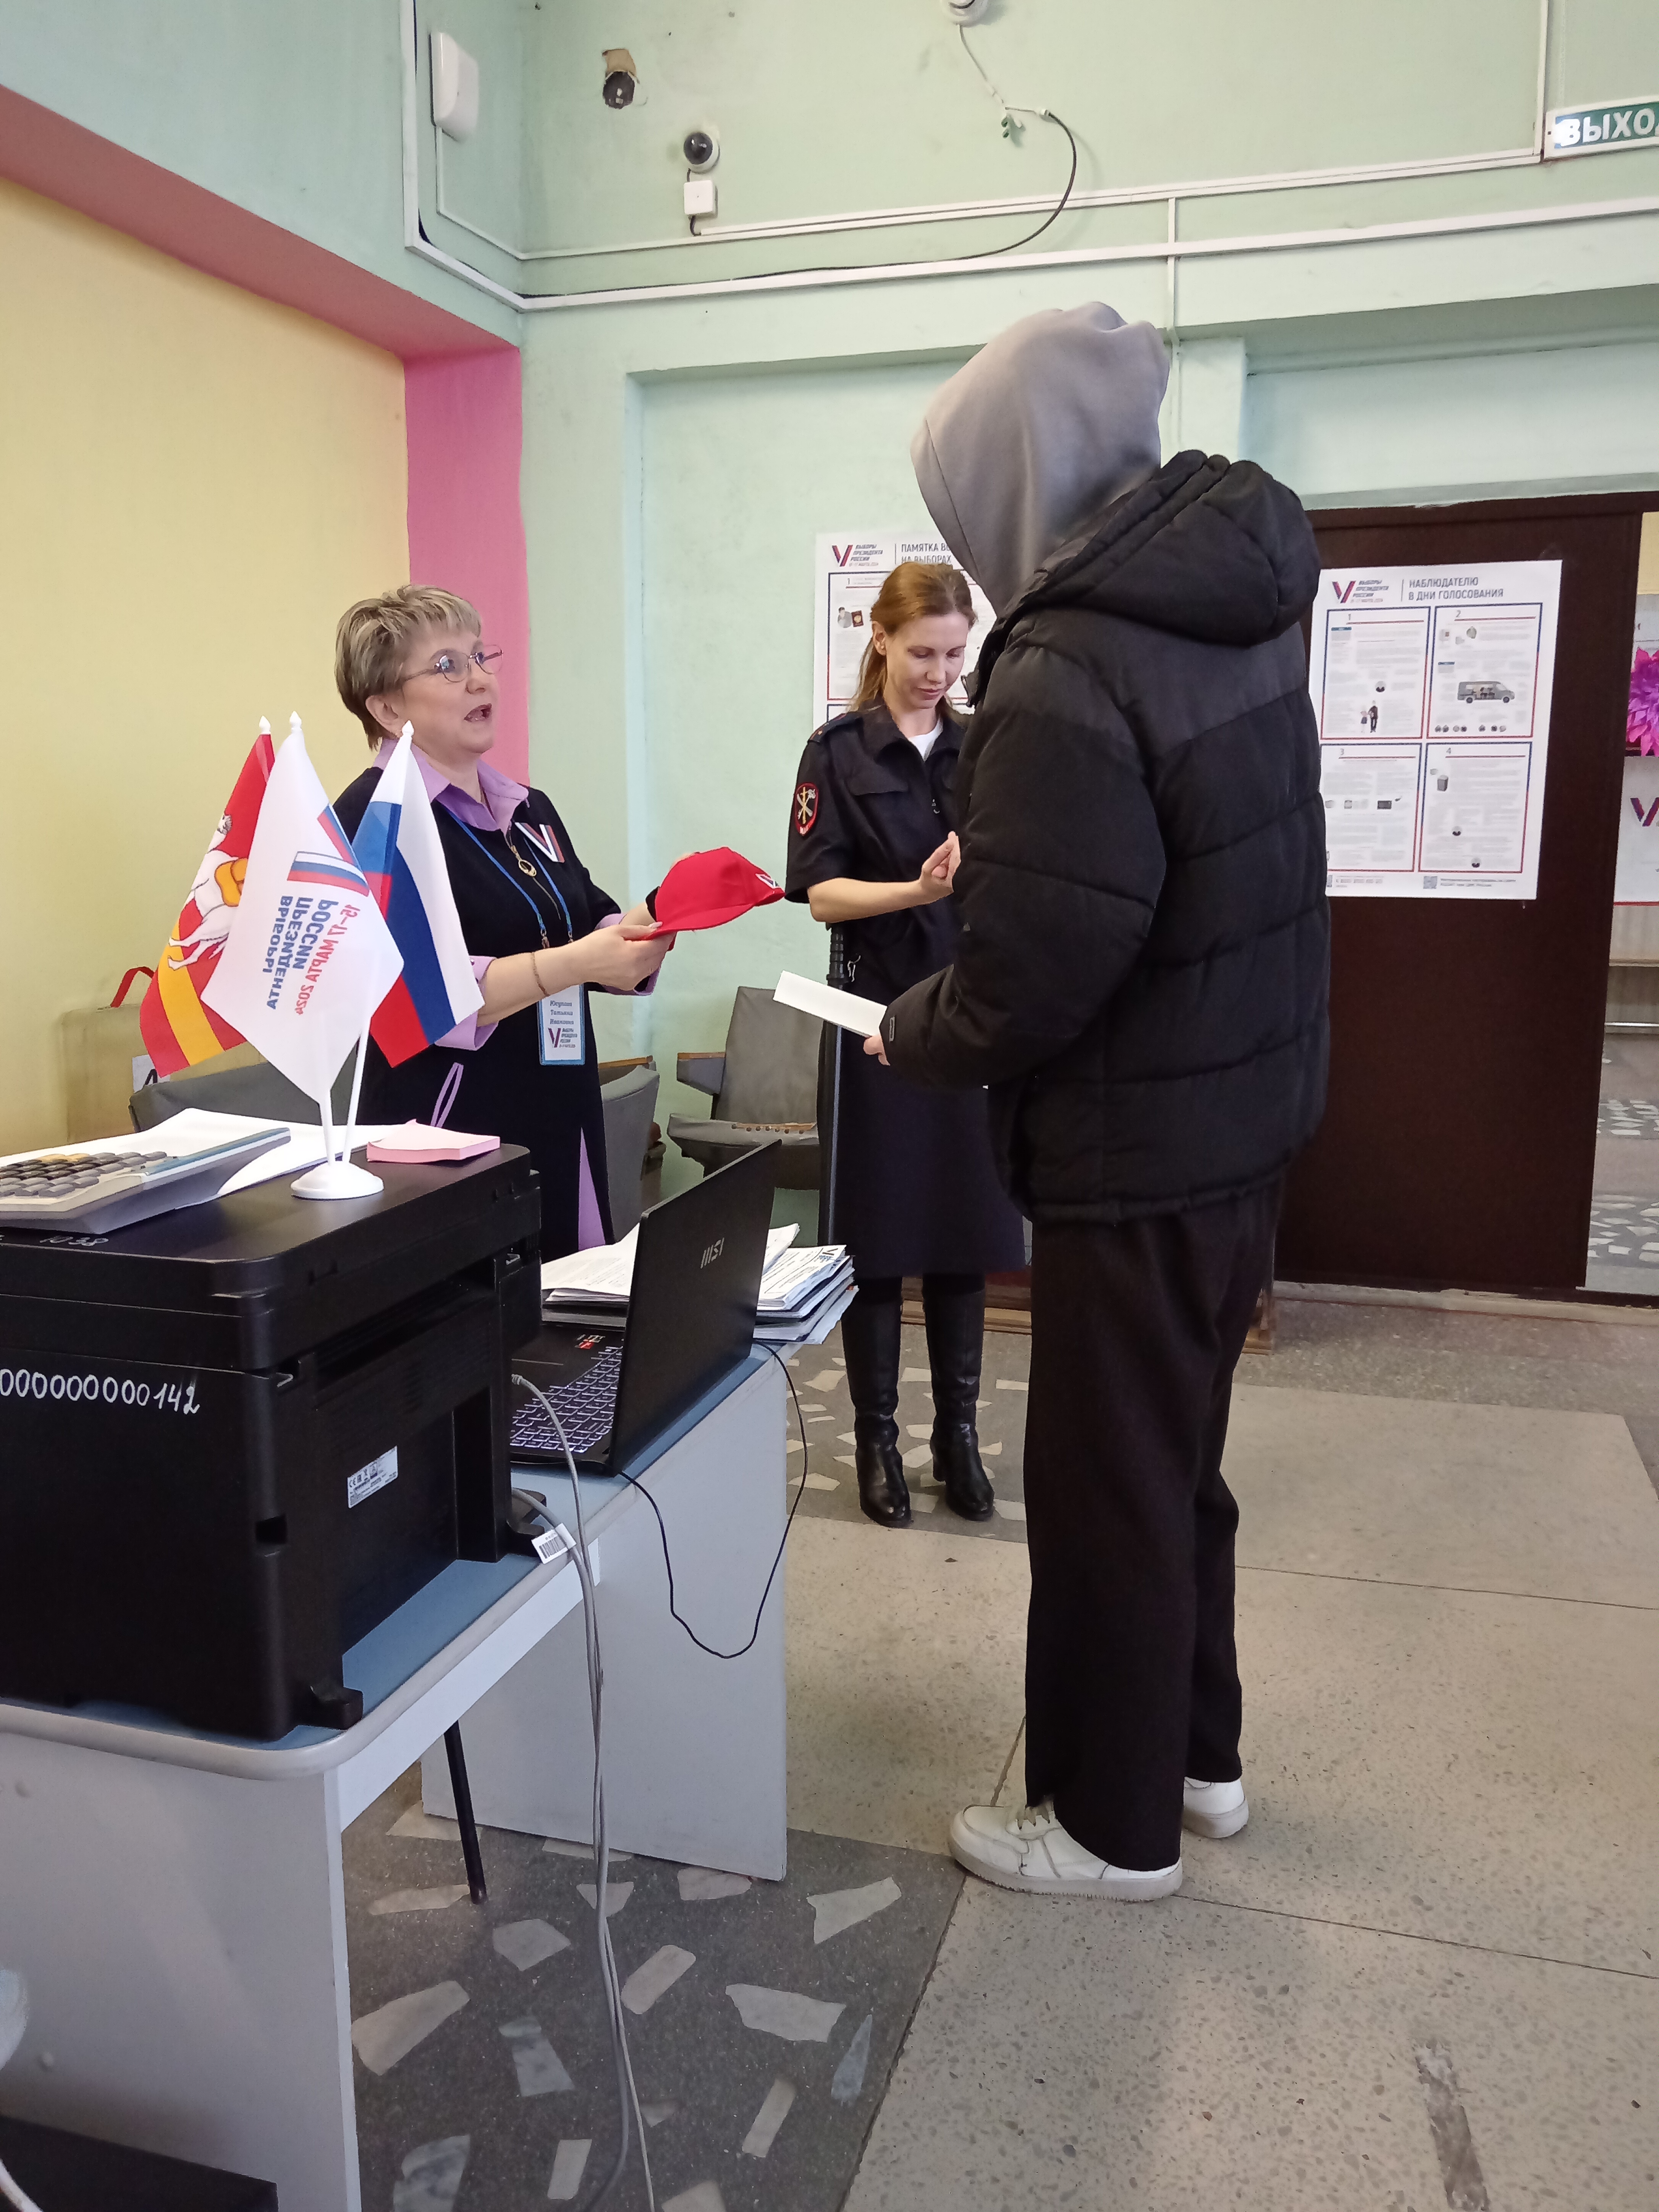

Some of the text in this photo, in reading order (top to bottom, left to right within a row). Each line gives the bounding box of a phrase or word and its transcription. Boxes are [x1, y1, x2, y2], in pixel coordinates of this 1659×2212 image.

[1555, 108, 1659, 147] ВЫХО
[901, 543, 939, 552] ПАМЯТКА
[1409, 576, 1479, 588] НАБЛЮДАТЕЛЮ
[1408, 588, 1504, 601] В ДНИ ГОЛОСОВАНИЯ
